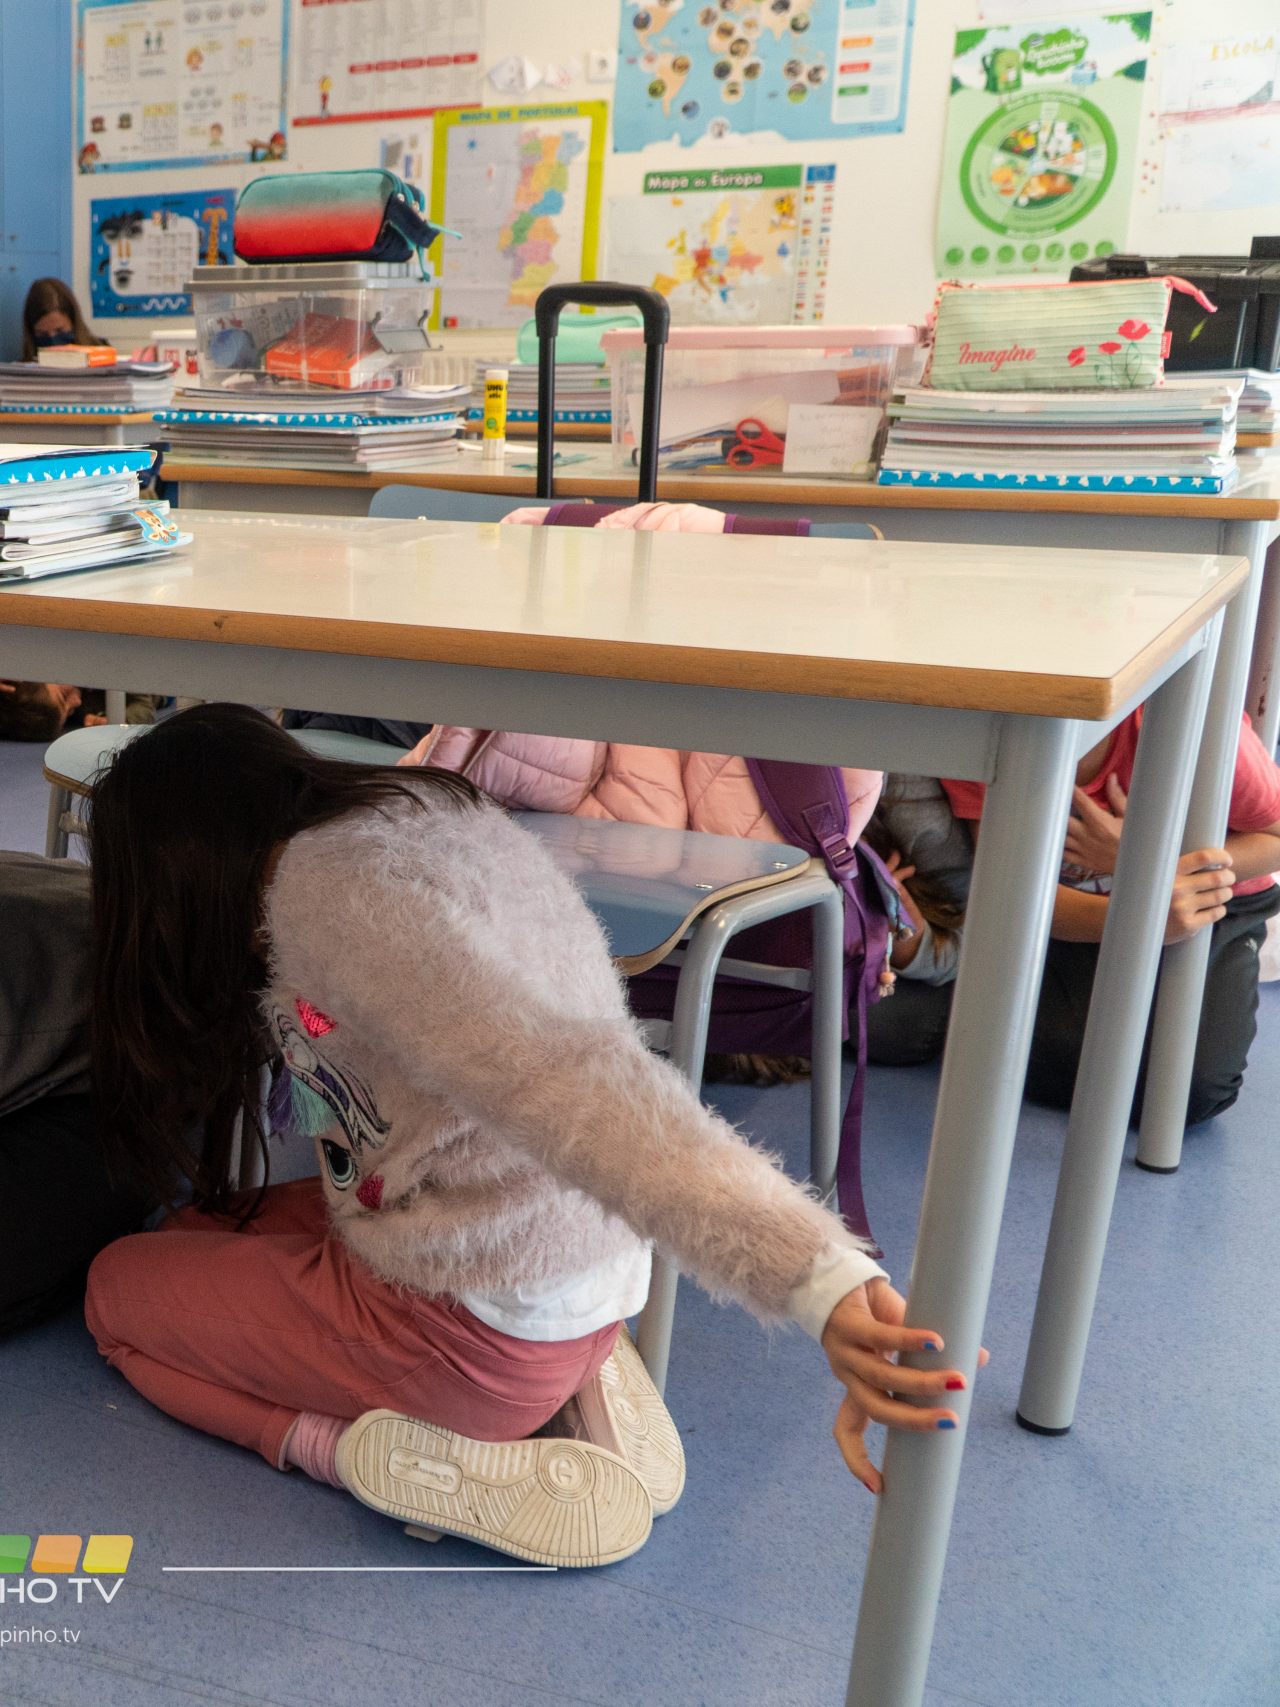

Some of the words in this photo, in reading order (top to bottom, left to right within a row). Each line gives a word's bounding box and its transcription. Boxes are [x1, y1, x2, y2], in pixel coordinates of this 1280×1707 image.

[648, 175, 689, 191] Mapa
[710, 171, 763, 188] Europa
[959, 342, 1036, 372] Imagine
